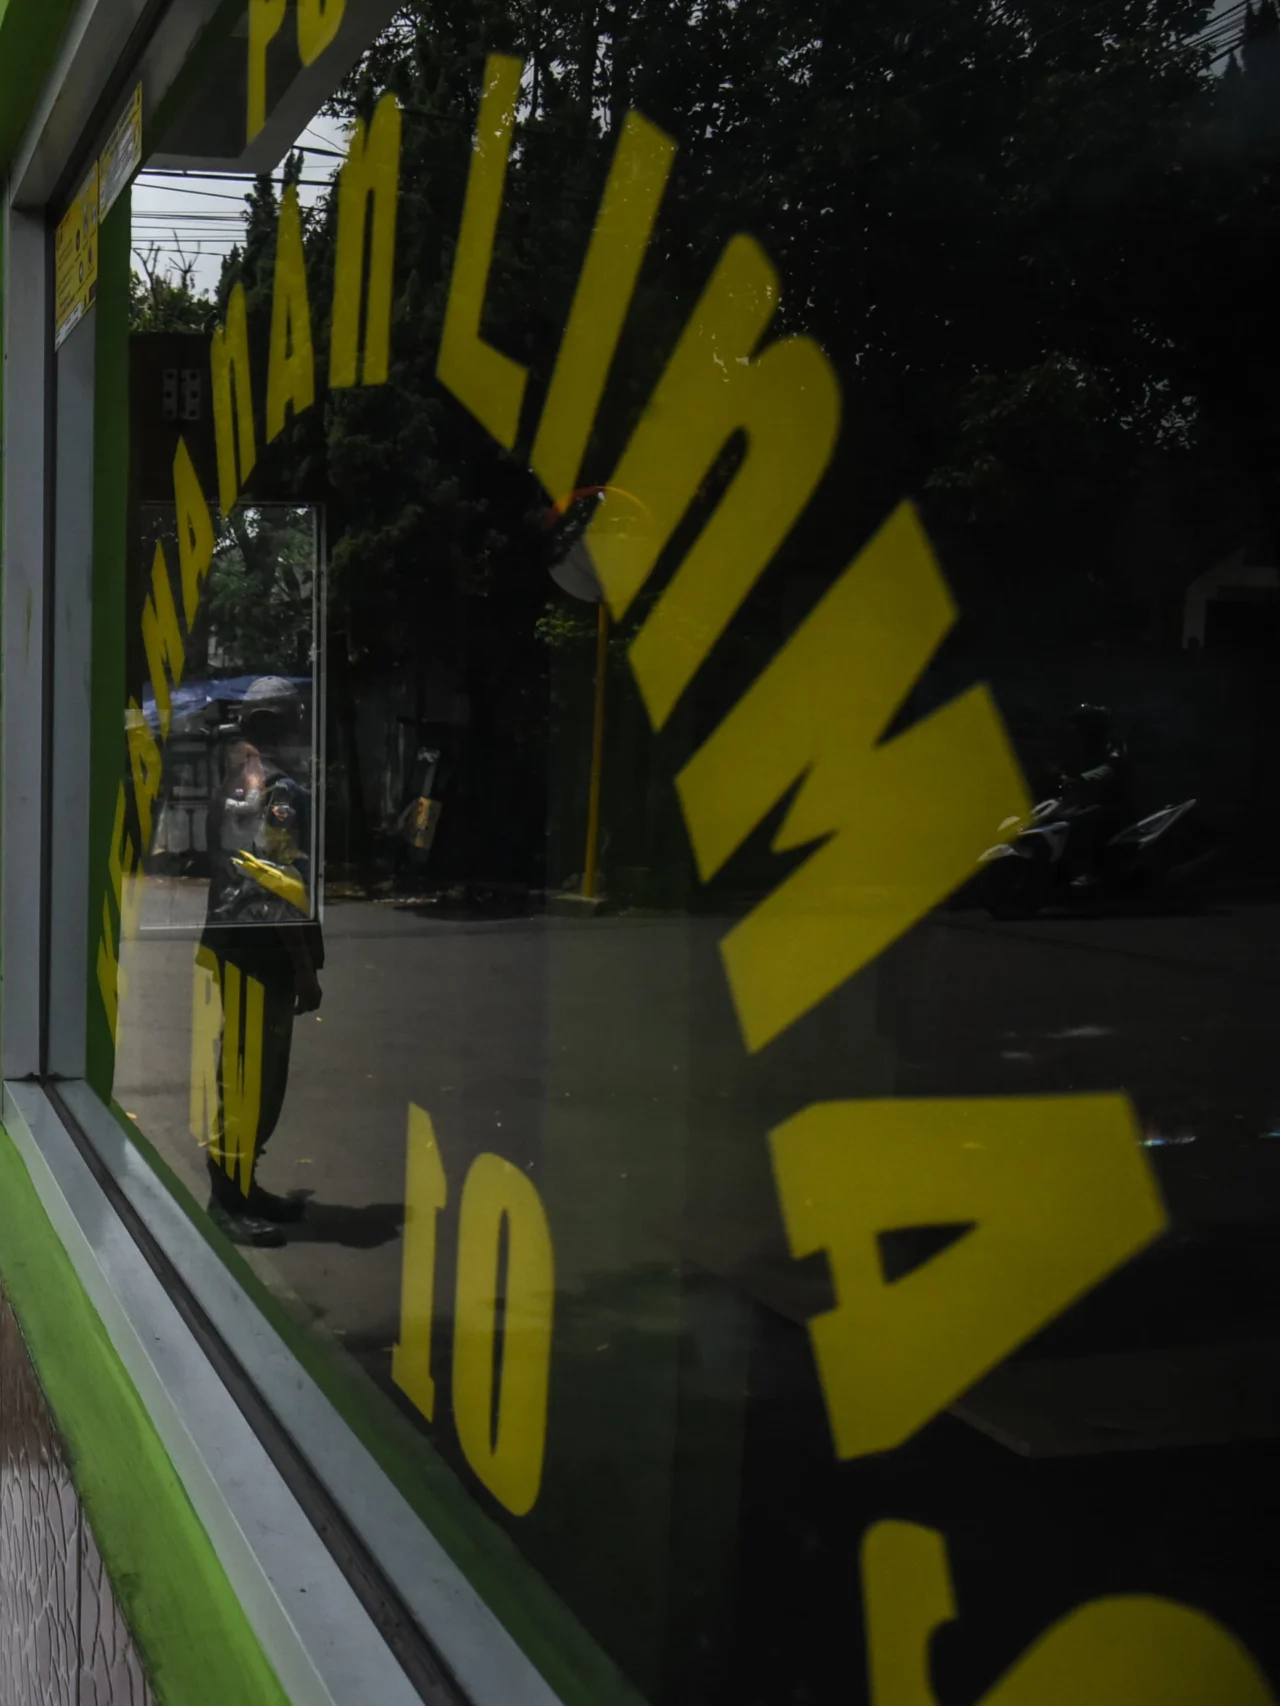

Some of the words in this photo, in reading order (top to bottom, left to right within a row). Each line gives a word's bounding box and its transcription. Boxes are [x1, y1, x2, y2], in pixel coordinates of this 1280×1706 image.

[96, 93, 402, 1047] KEAMANAN
[189, 942, 265, 1198] RW
[391, 1101, 556, 1518] 10
